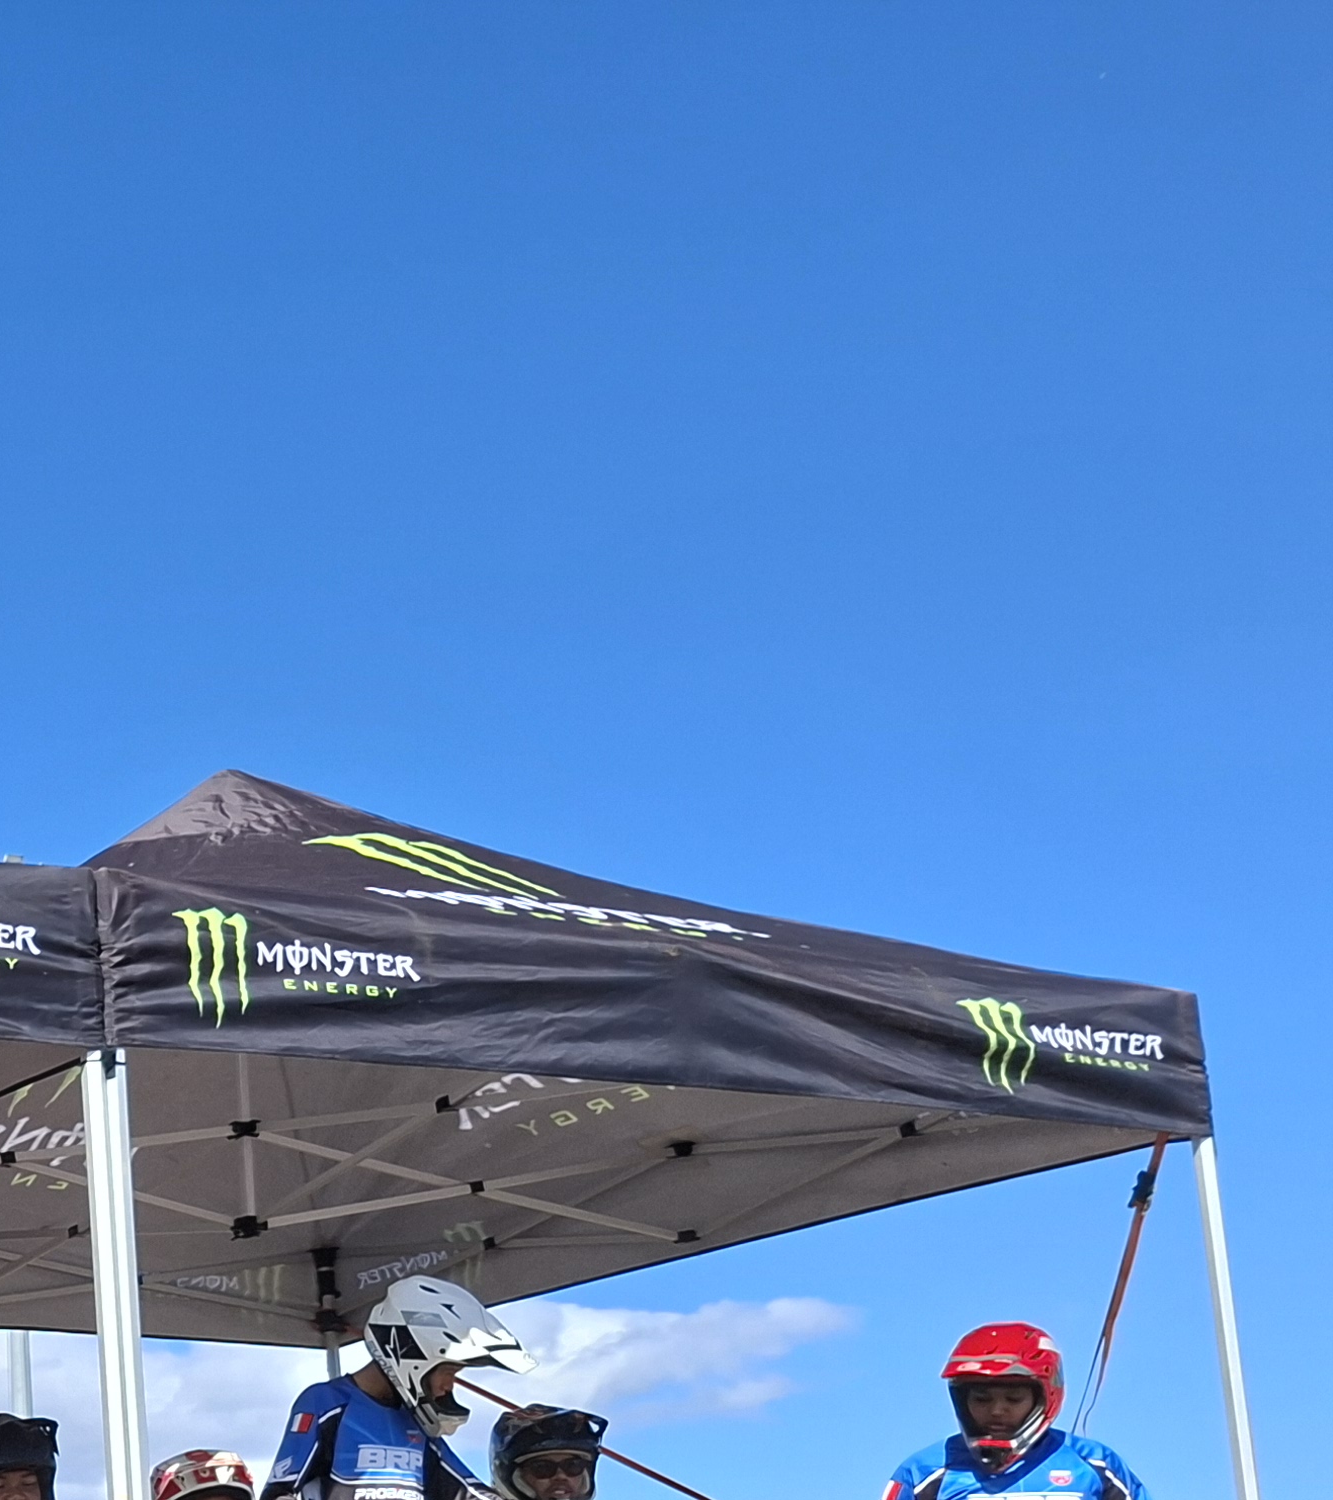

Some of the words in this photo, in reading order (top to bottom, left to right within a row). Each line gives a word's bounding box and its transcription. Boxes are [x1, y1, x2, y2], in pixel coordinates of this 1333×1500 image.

[257, 937, 421, 983] MONSTER
[283, 979, 399, 1000] ENERGY
[1029, 1022, 1165, 1061] MONSTER
[1064, 1052, 1151, 1073] ENERGY
